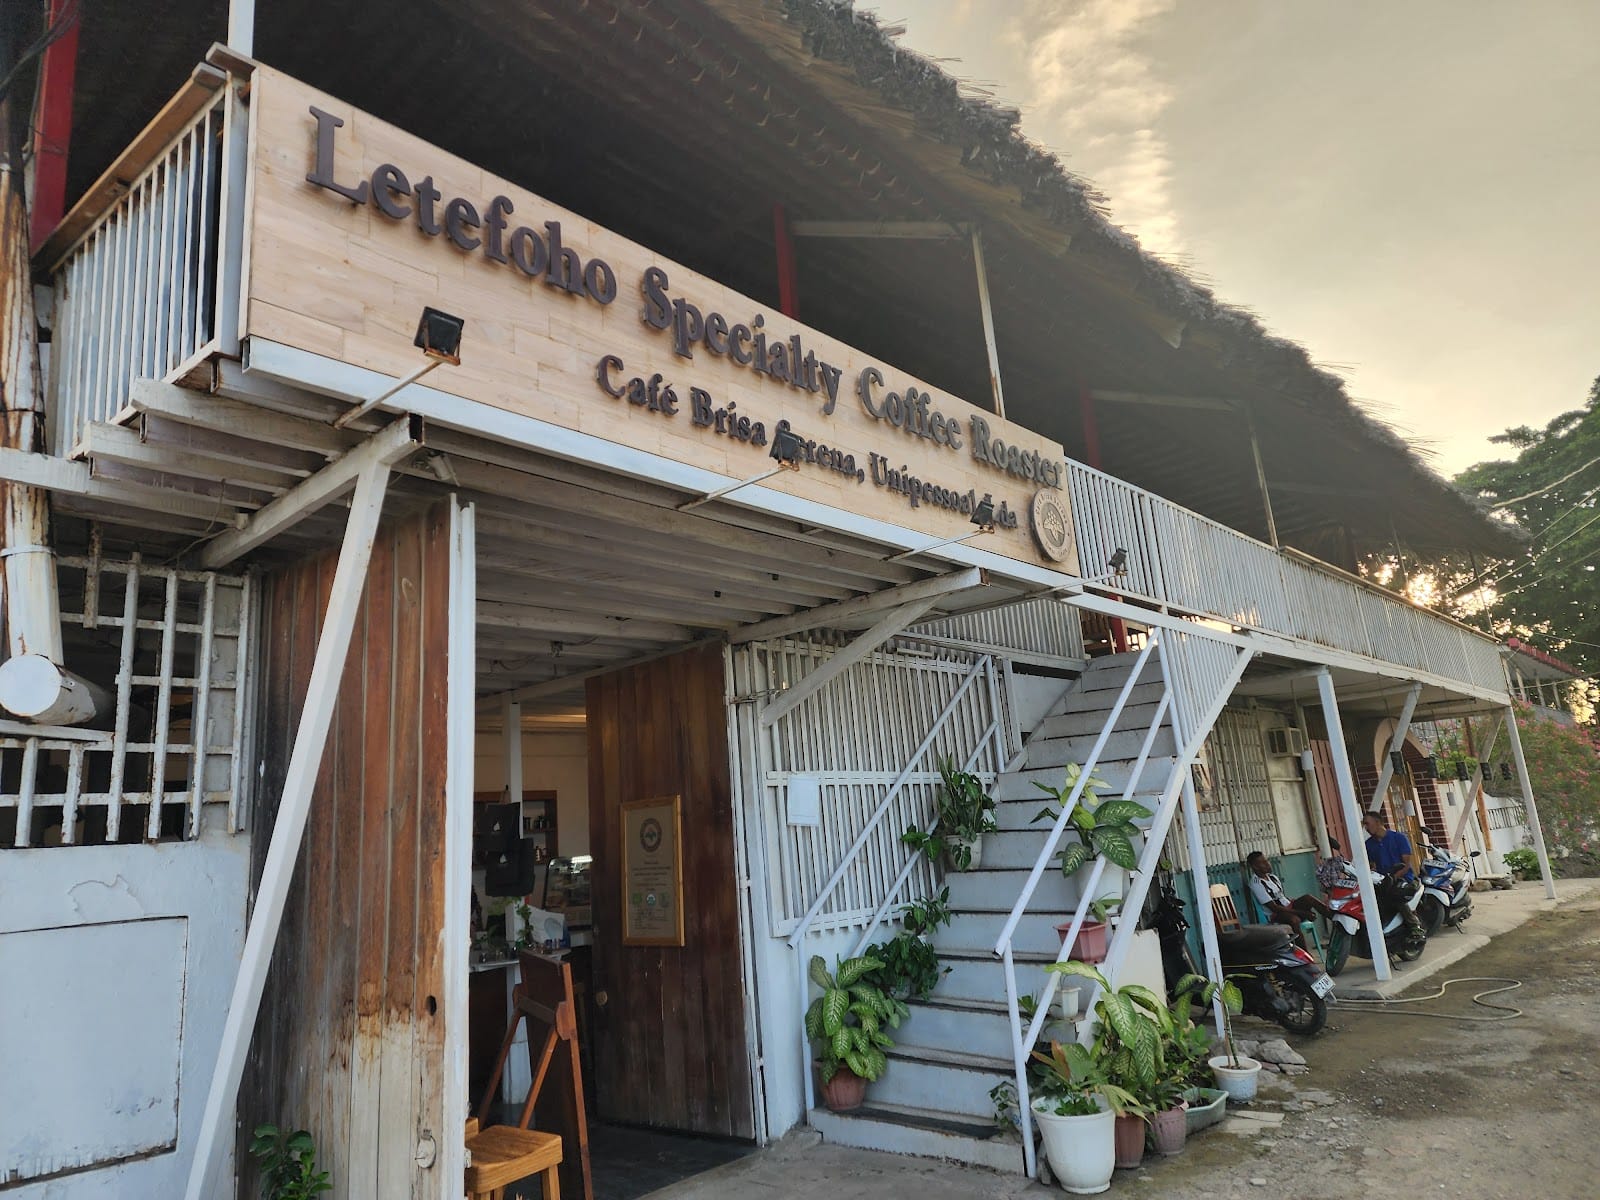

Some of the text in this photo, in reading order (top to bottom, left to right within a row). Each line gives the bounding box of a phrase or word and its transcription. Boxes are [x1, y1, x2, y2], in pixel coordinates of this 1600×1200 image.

[306, 105, 1063, 490] Letefoho Specialty Coffee Roaster
[597, 354, 679, 416] Café
[690, 386, 768, 447] Brisa
[868, 451, 976, 514] Unipessoal
[982, 493, 1018, 529] da
